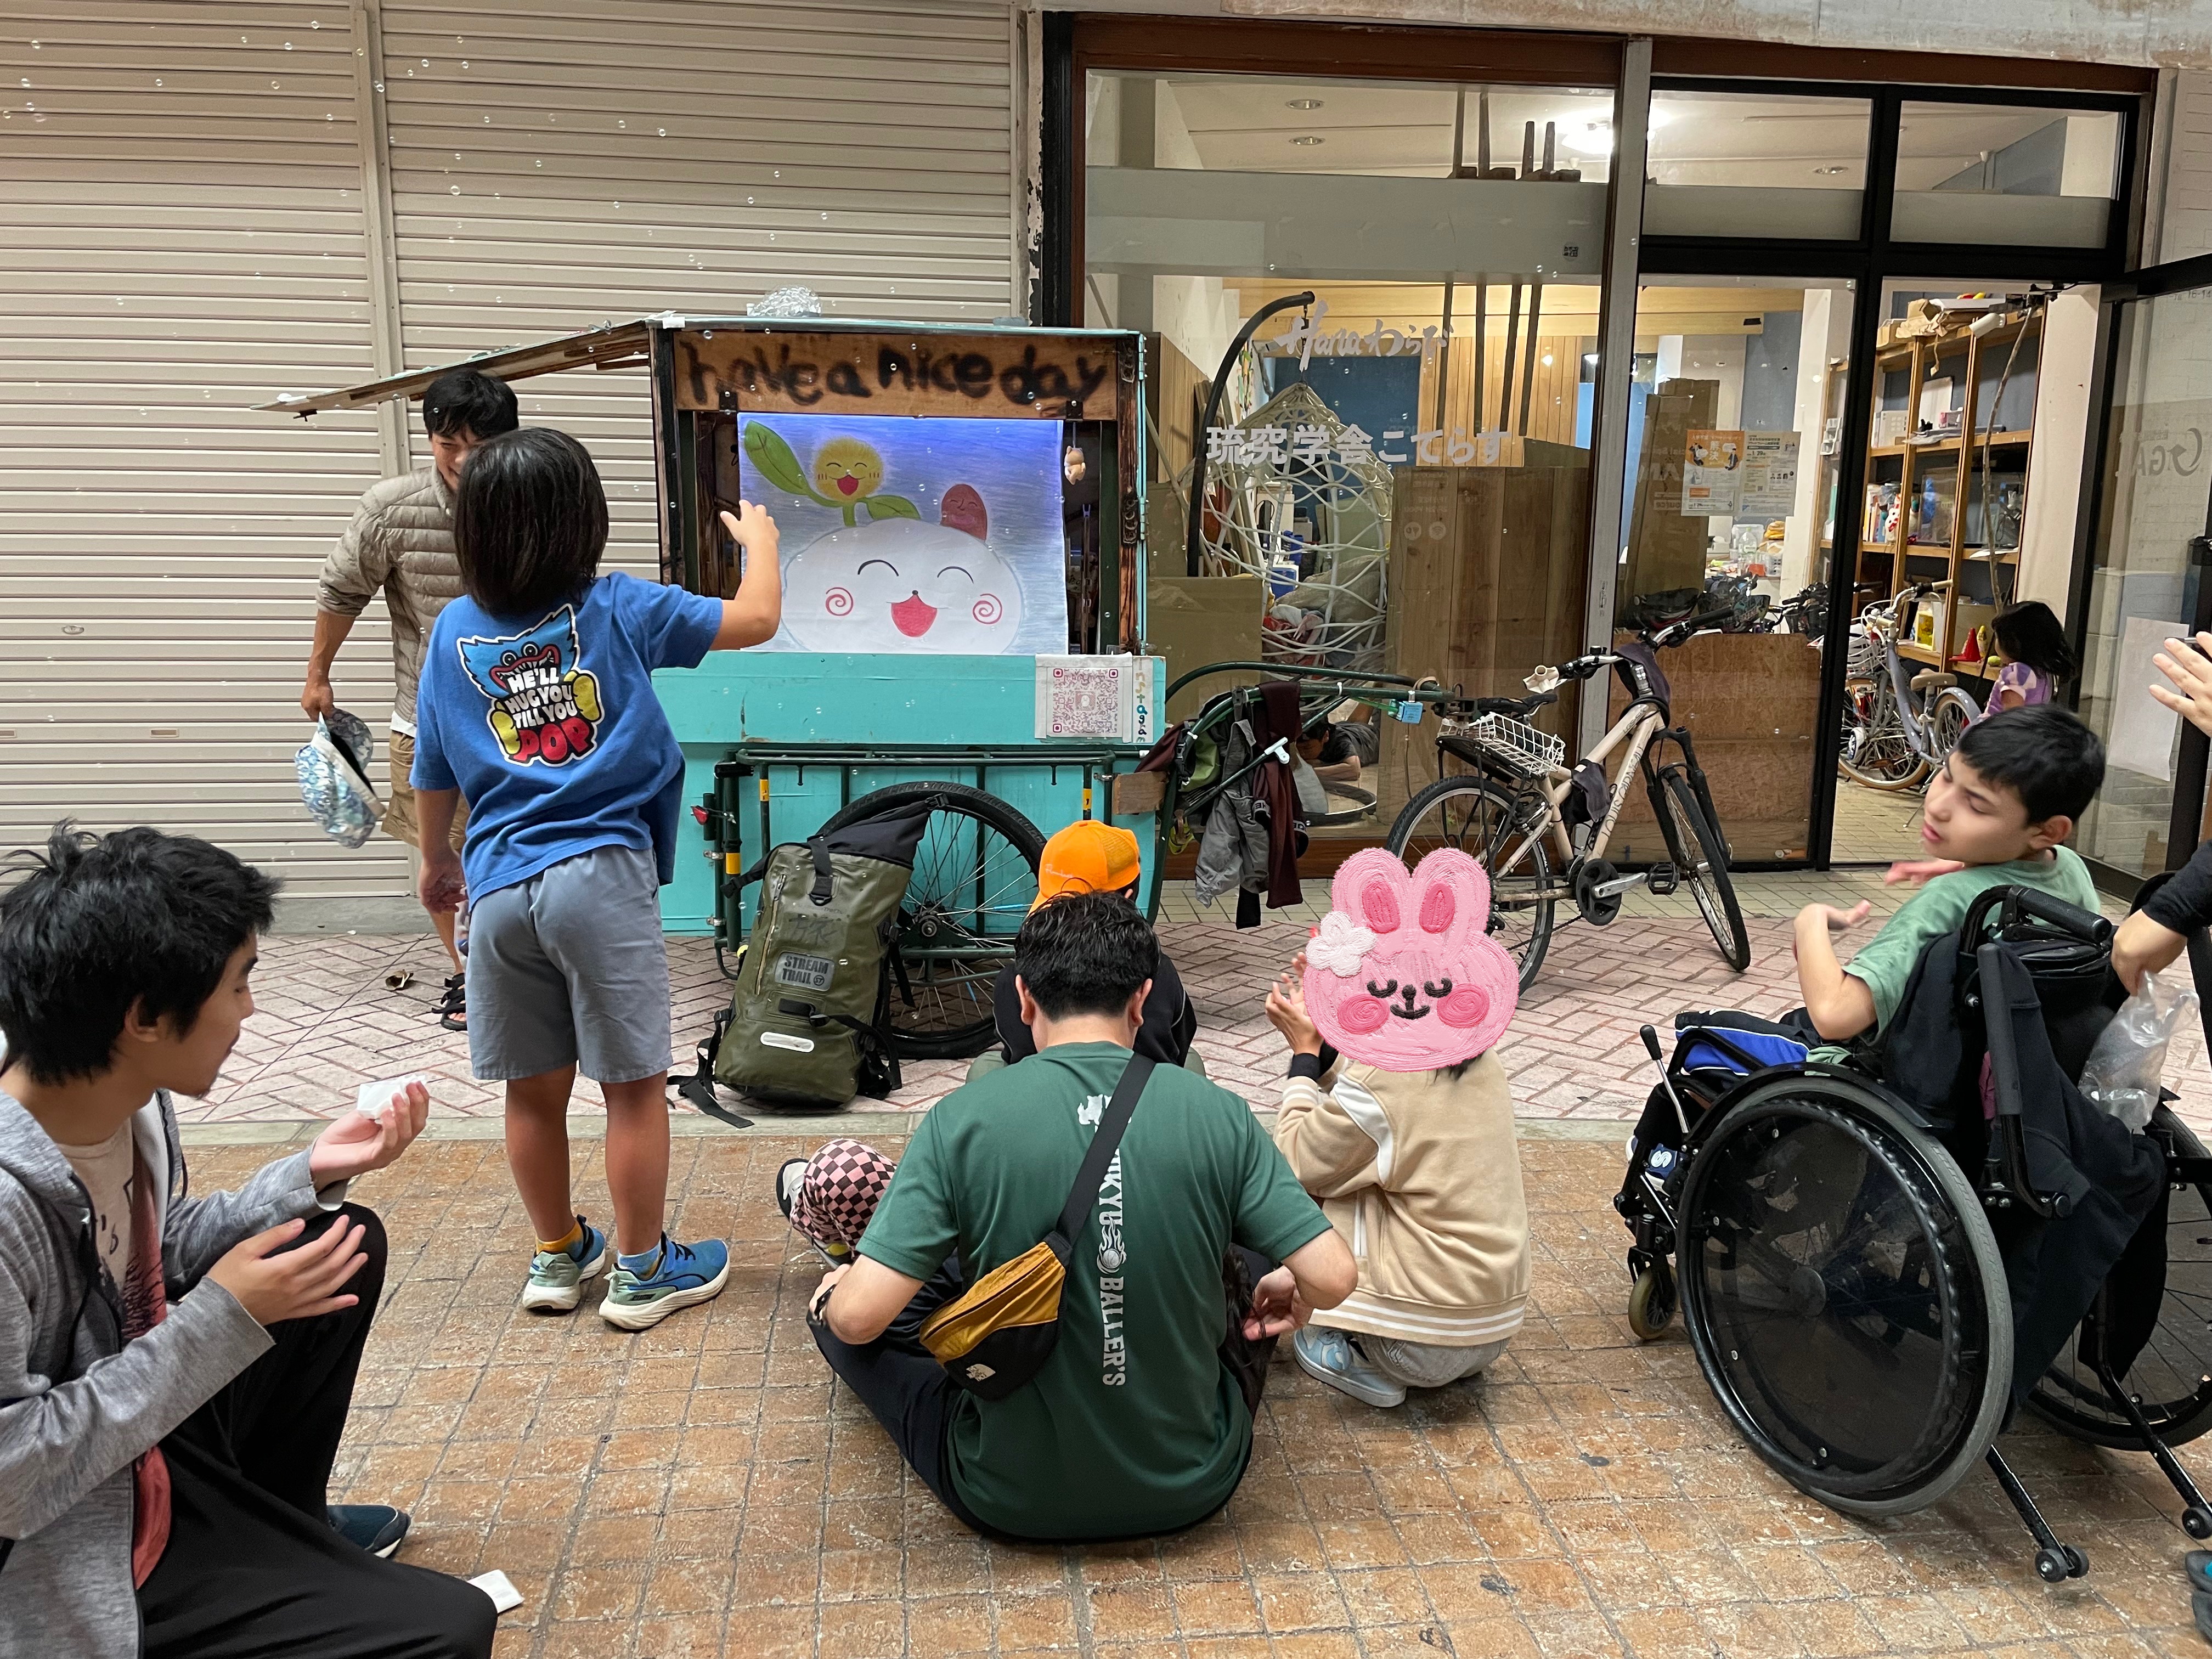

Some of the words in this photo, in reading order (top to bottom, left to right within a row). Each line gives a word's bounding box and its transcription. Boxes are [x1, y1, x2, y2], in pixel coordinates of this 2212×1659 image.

[826, 359, 873, 398] a
[878, 337, 995, 399] nice
[1000, 344, 1108, 409] day
[507, 667, 560, 693] HE'LL
[504, 690, 542, 714] HUG
[538, 685, 573, 706] YOU
[512, 706, 544, 729] TILL
[543, 701, 577, 722] YOU
[514, 716, 590, 761] POP
[782, 968, 811, 984] TRAIL
[785, 955, 829, 974] STREAM
[1100, 1276, 1126, 1387] BALLER'S
